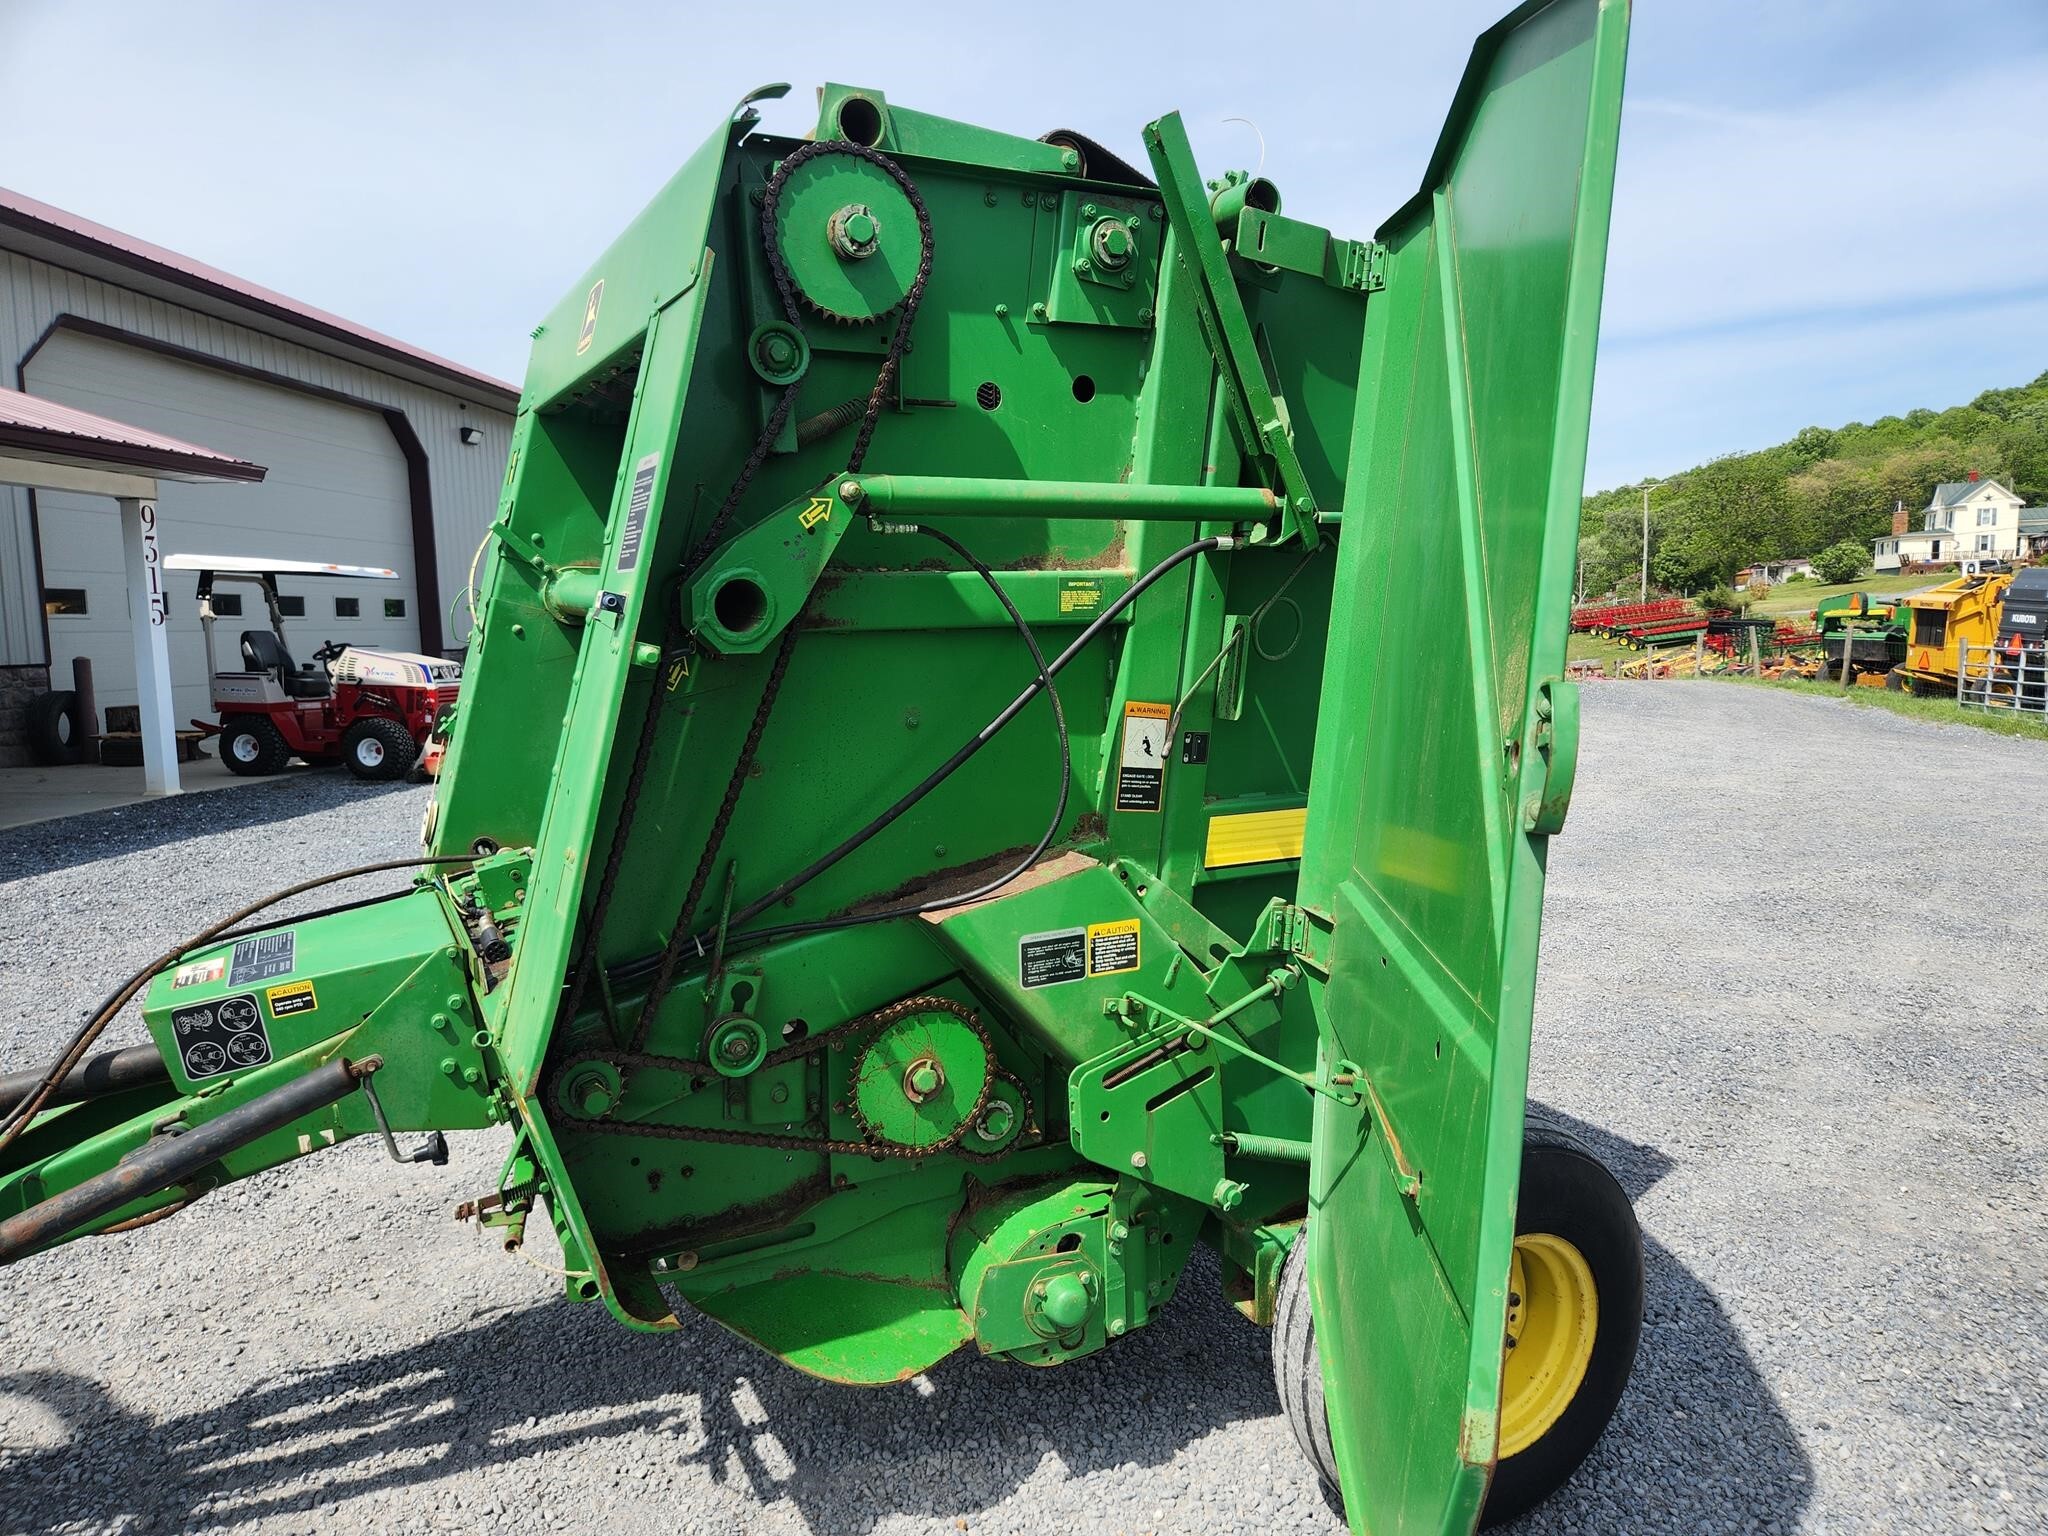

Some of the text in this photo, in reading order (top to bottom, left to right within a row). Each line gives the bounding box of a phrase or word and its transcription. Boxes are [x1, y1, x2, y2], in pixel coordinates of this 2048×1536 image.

[141, 505, 164, 626] 9315
[2012, 614, 2036, 624] KUBOTA
[1136, 706, 1166, 715] WARNING
[1101, 925, 1135, 936] CAUTION
[276, 984, 310, 995] CAUTION
